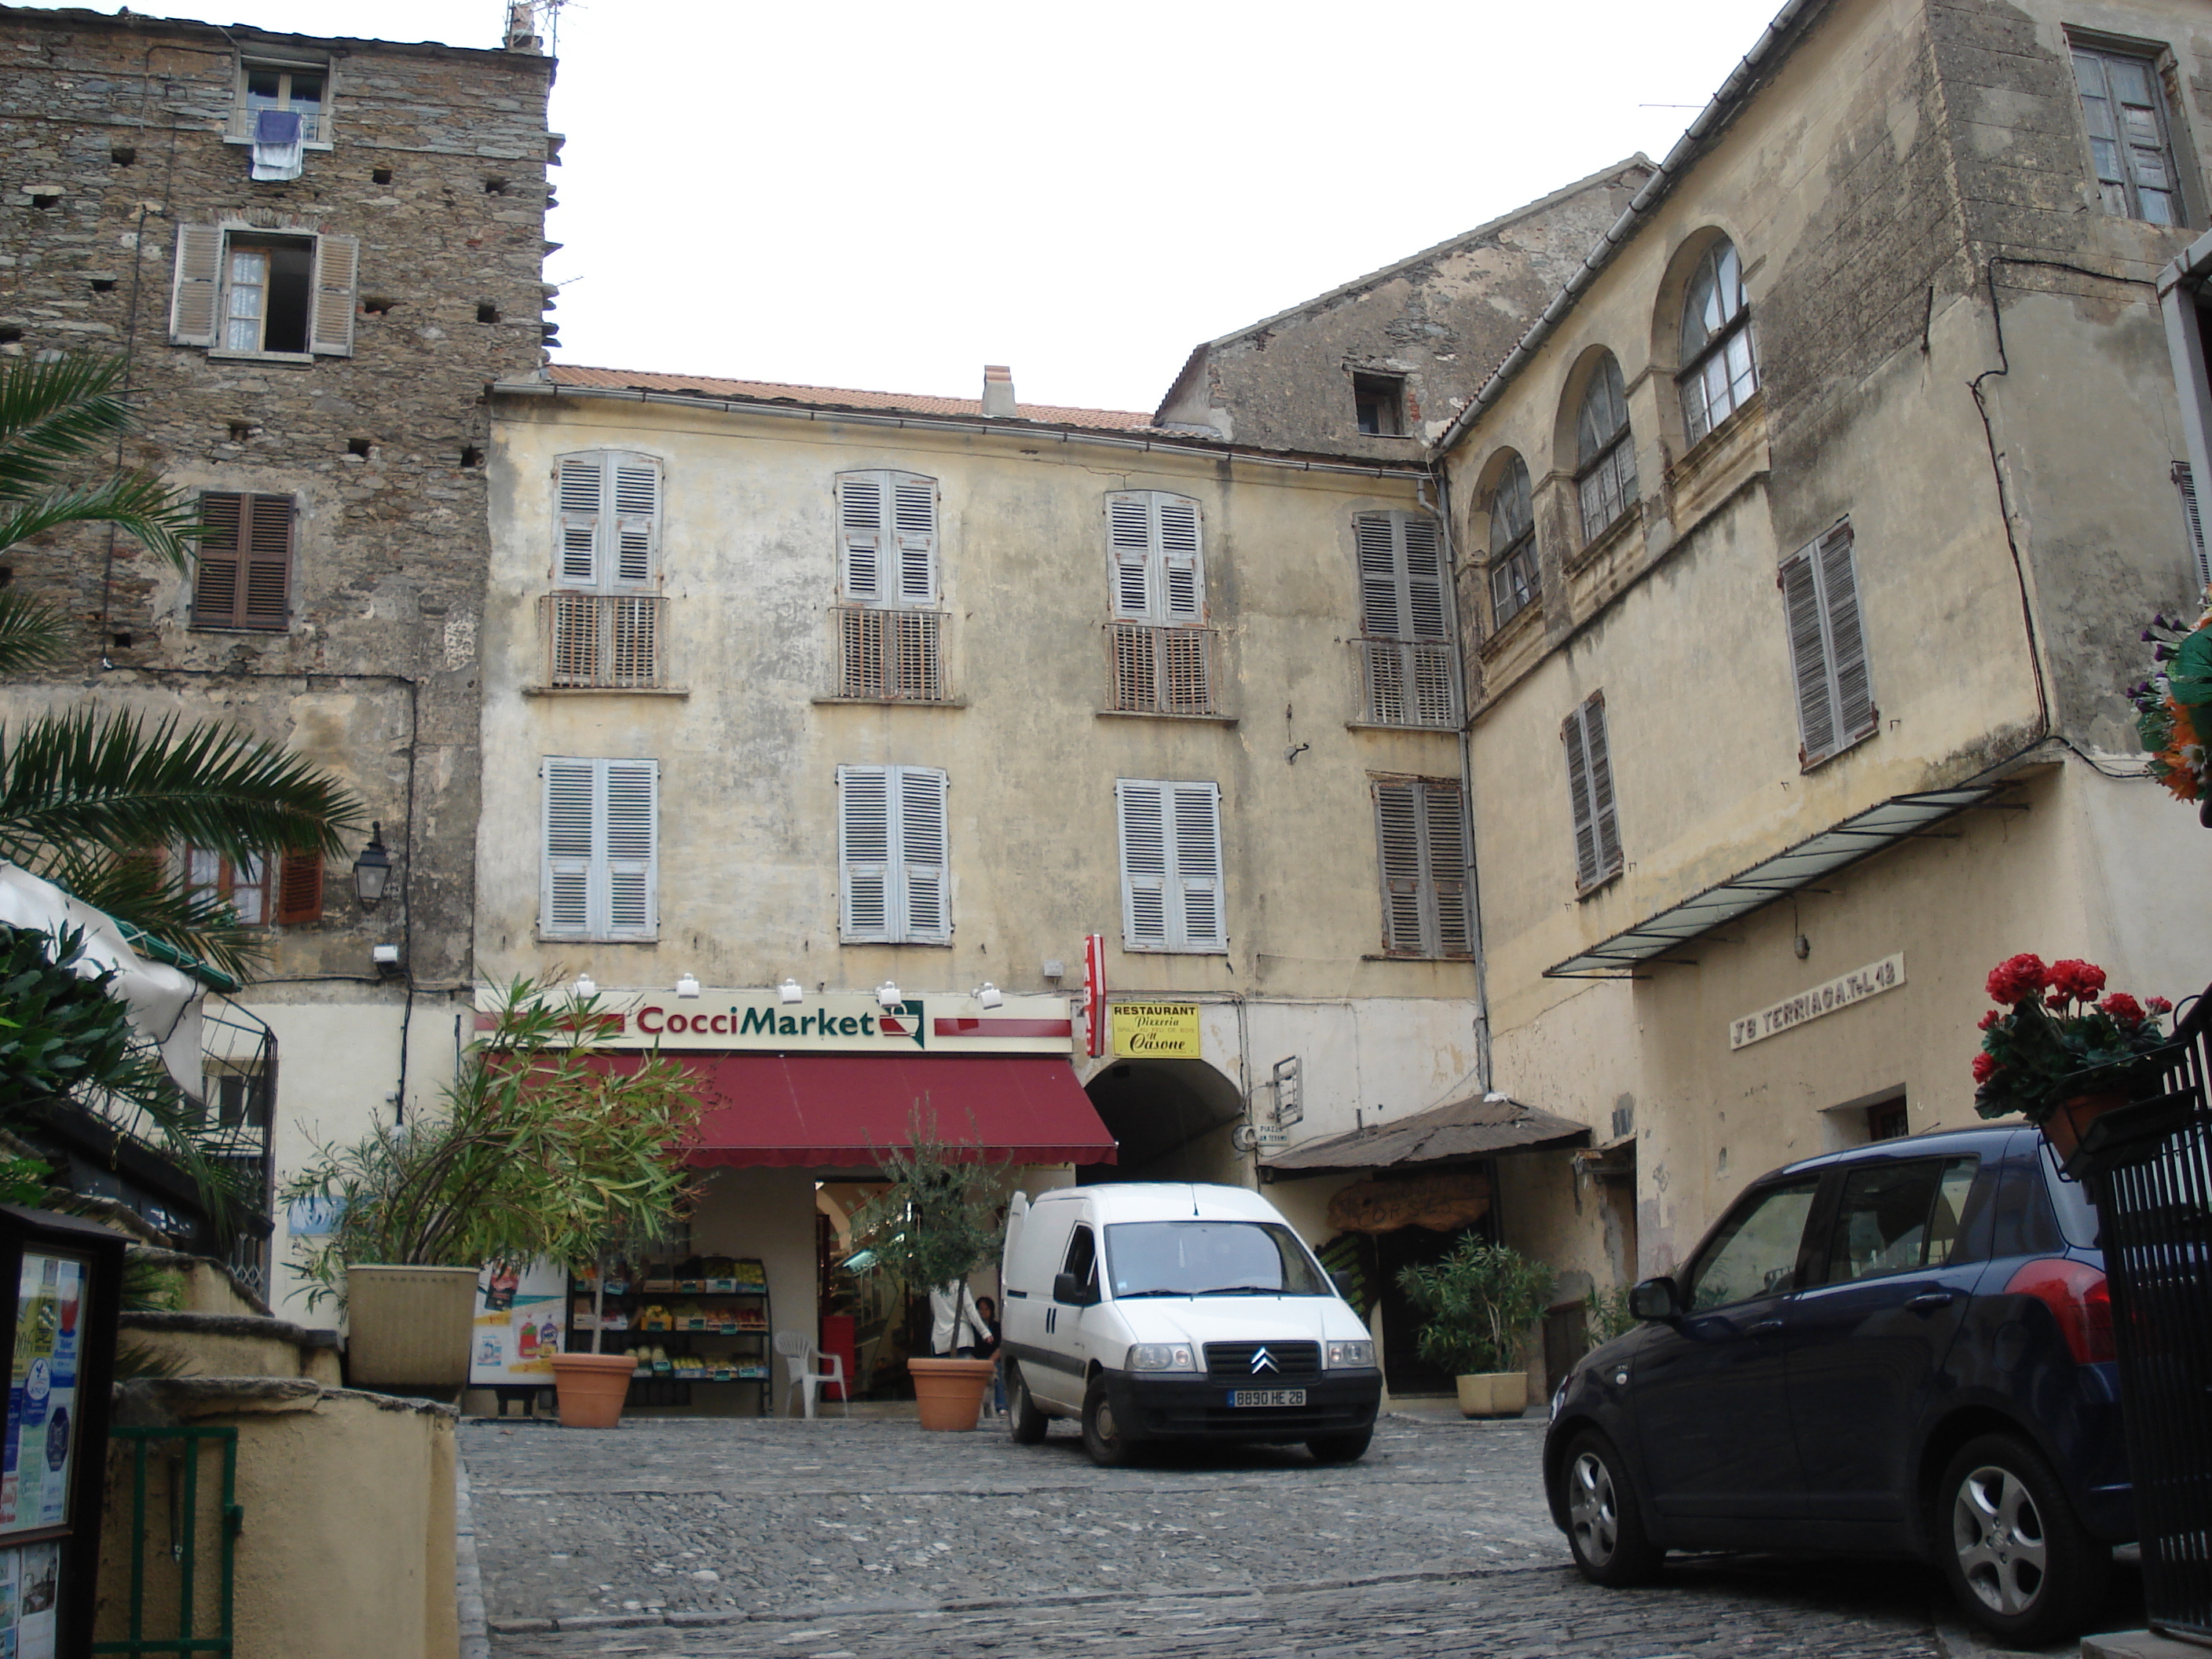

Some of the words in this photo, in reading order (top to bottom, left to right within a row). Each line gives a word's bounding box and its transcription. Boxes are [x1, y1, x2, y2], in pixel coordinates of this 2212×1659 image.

[1114, 1006, 1196, 1016] RESTAURANT
[637, 1006, 874, 1035] CocciMarket
[1135, 1016, 1179, 1027] Pizzeria
[1130, 1033, 1185, 1053] Casone
[1236, 1392, 1269, 1405] 8890
[1272, 1392, 1285, 1404] HE
[1289, 1391, 1303, 1404] 2B
